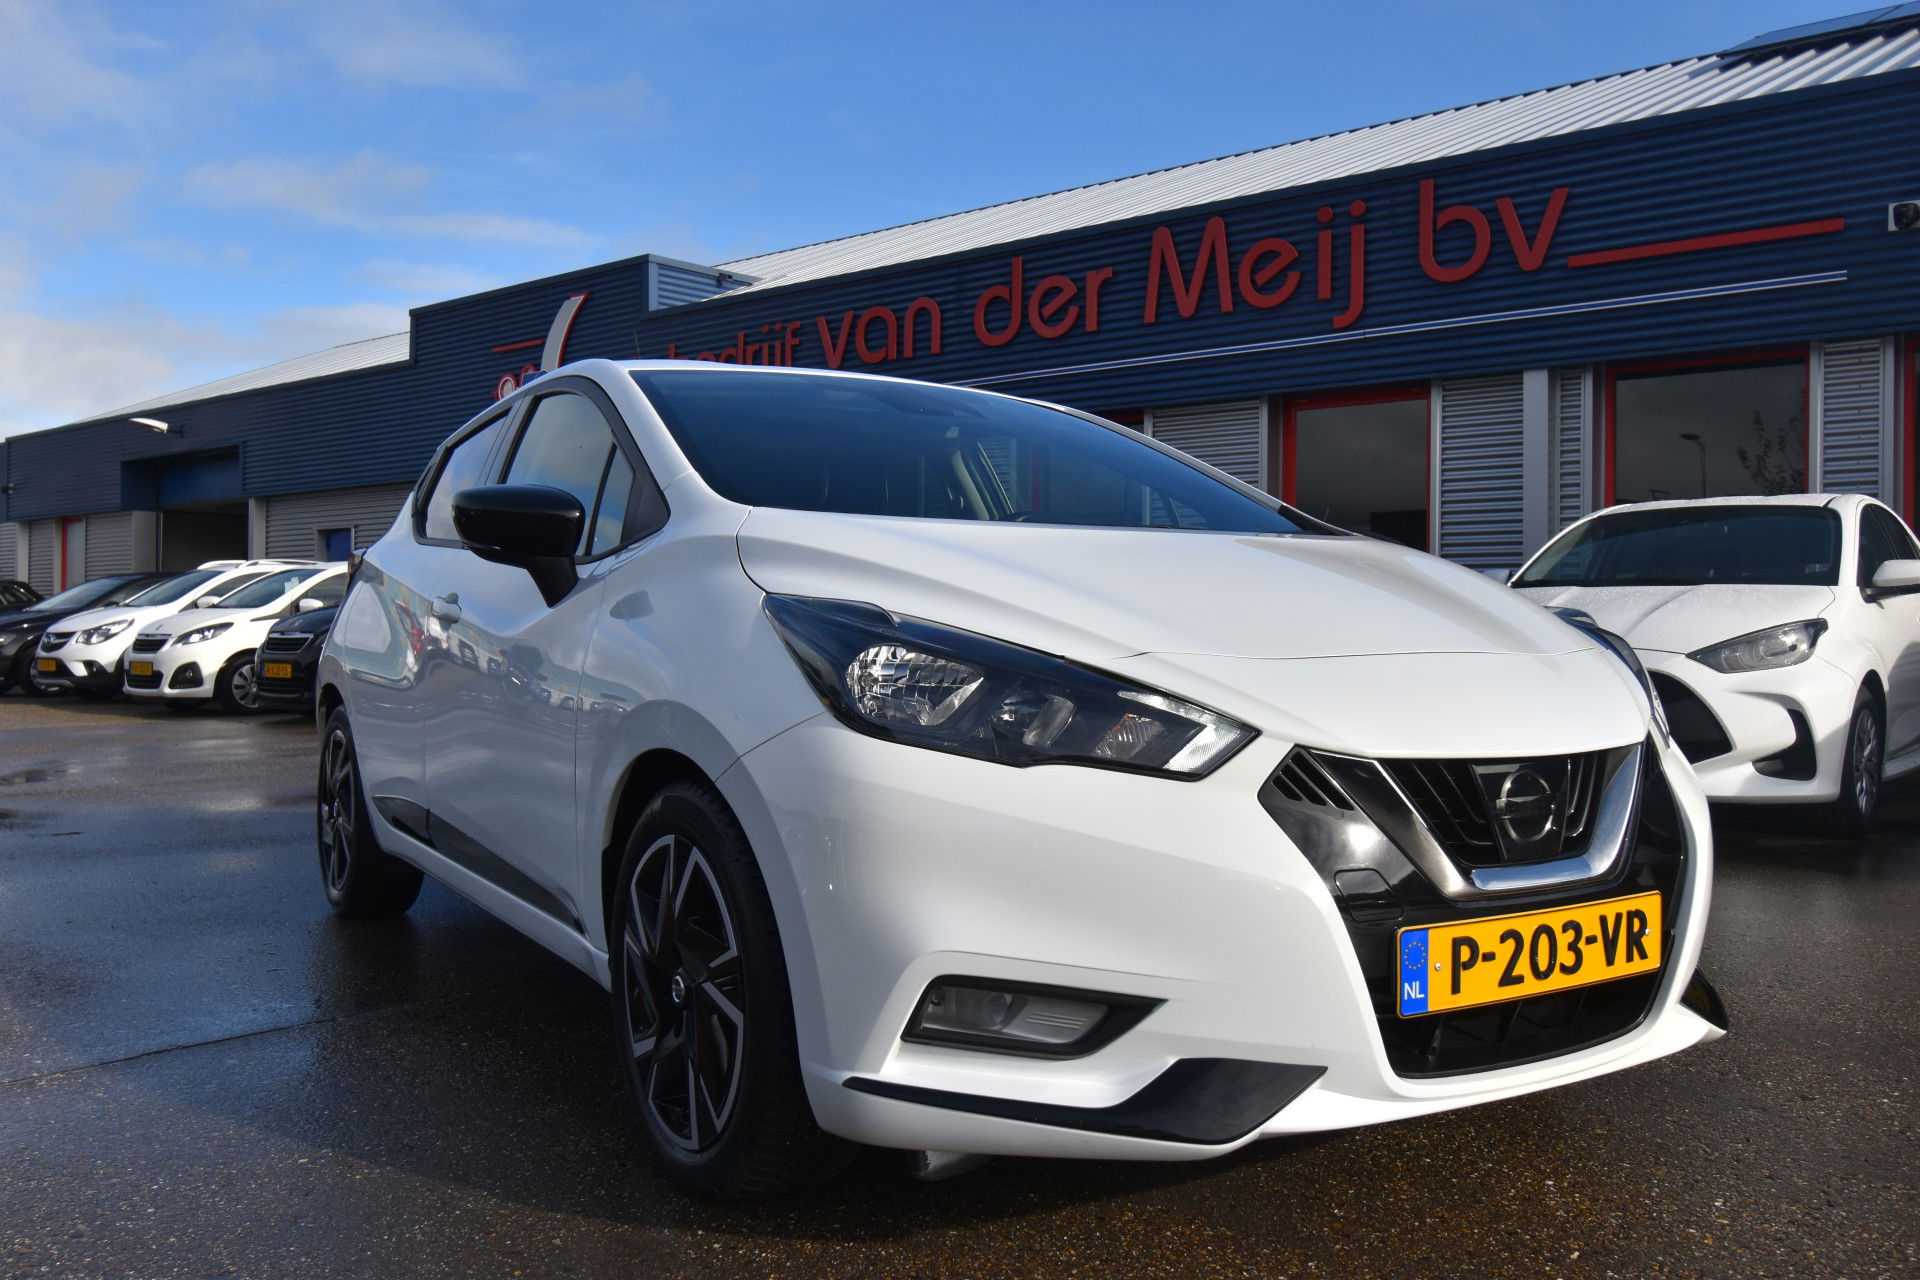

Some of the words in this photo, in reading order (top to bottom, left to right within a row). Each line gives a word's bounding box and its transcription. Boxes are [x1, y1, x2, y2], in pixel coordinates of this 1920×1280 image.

[816, 297, 941, 369] van
[974, 257, 1113, 346] der
[1143, 199, 1366, 329] Meij
[1419, 178, 1569, 282] bv
[1404, 982, 1425, 1000] NL
[1451, 909, 1648, 995] P-203-VR
